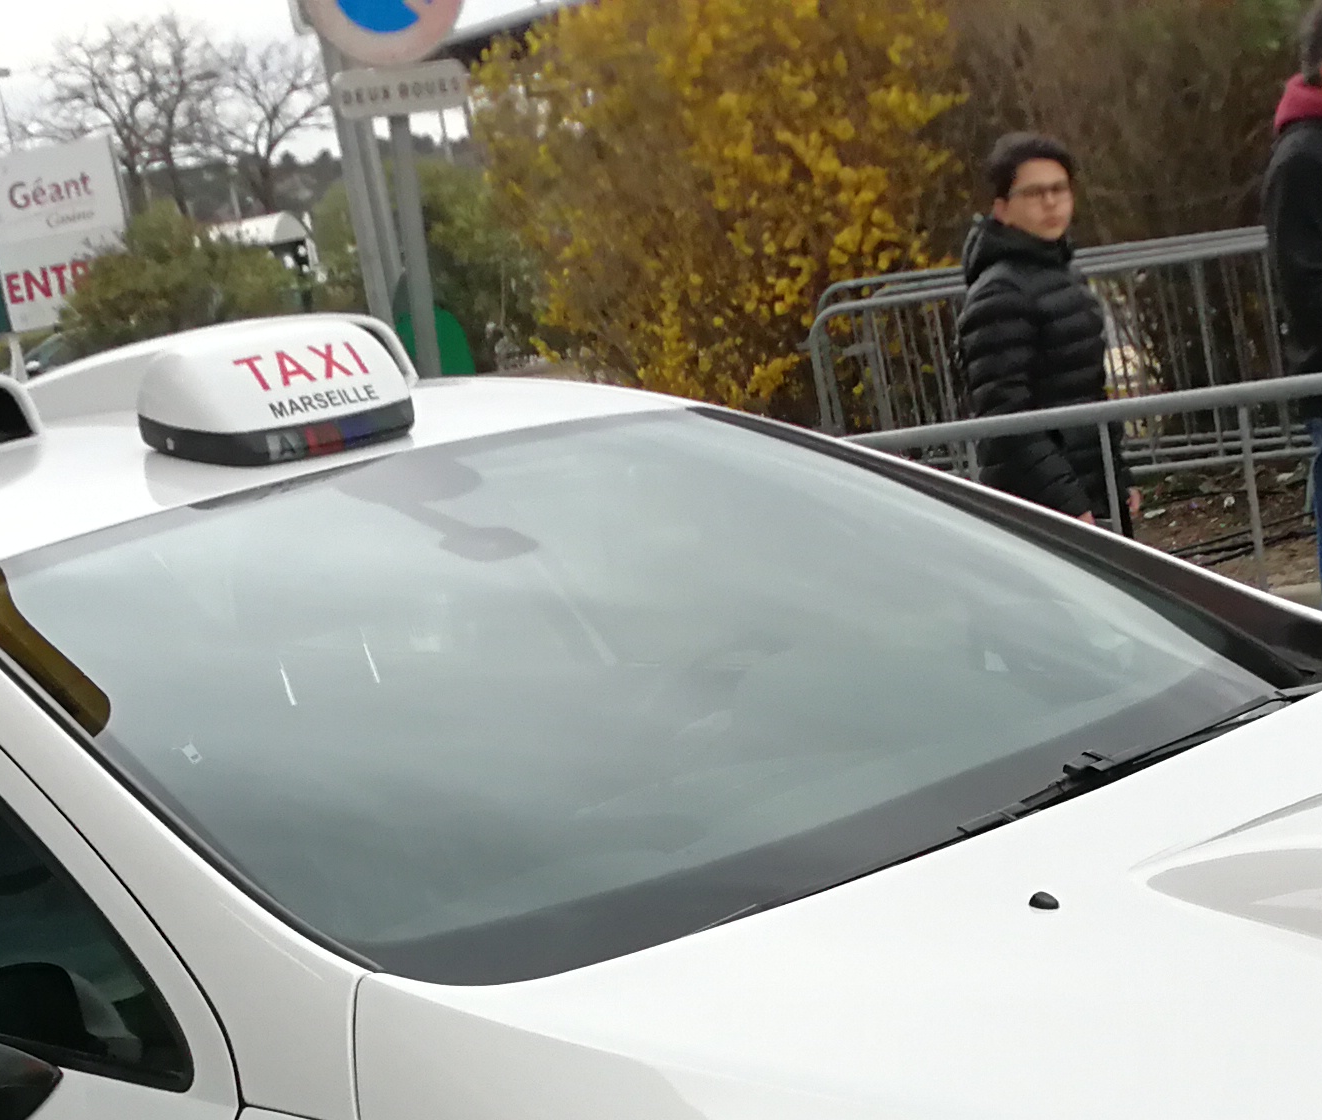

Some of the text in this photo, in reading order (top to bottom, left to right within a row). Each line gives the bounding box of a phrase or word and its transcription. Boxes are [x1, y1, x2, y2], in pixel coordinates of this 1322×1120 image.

[8, 171, 94, 210] Géant
[4, 257, 91, 304] ENTR
[233, 342, 370, 391] TAXI
[269, 384, 379, 420] MARSEILLE
